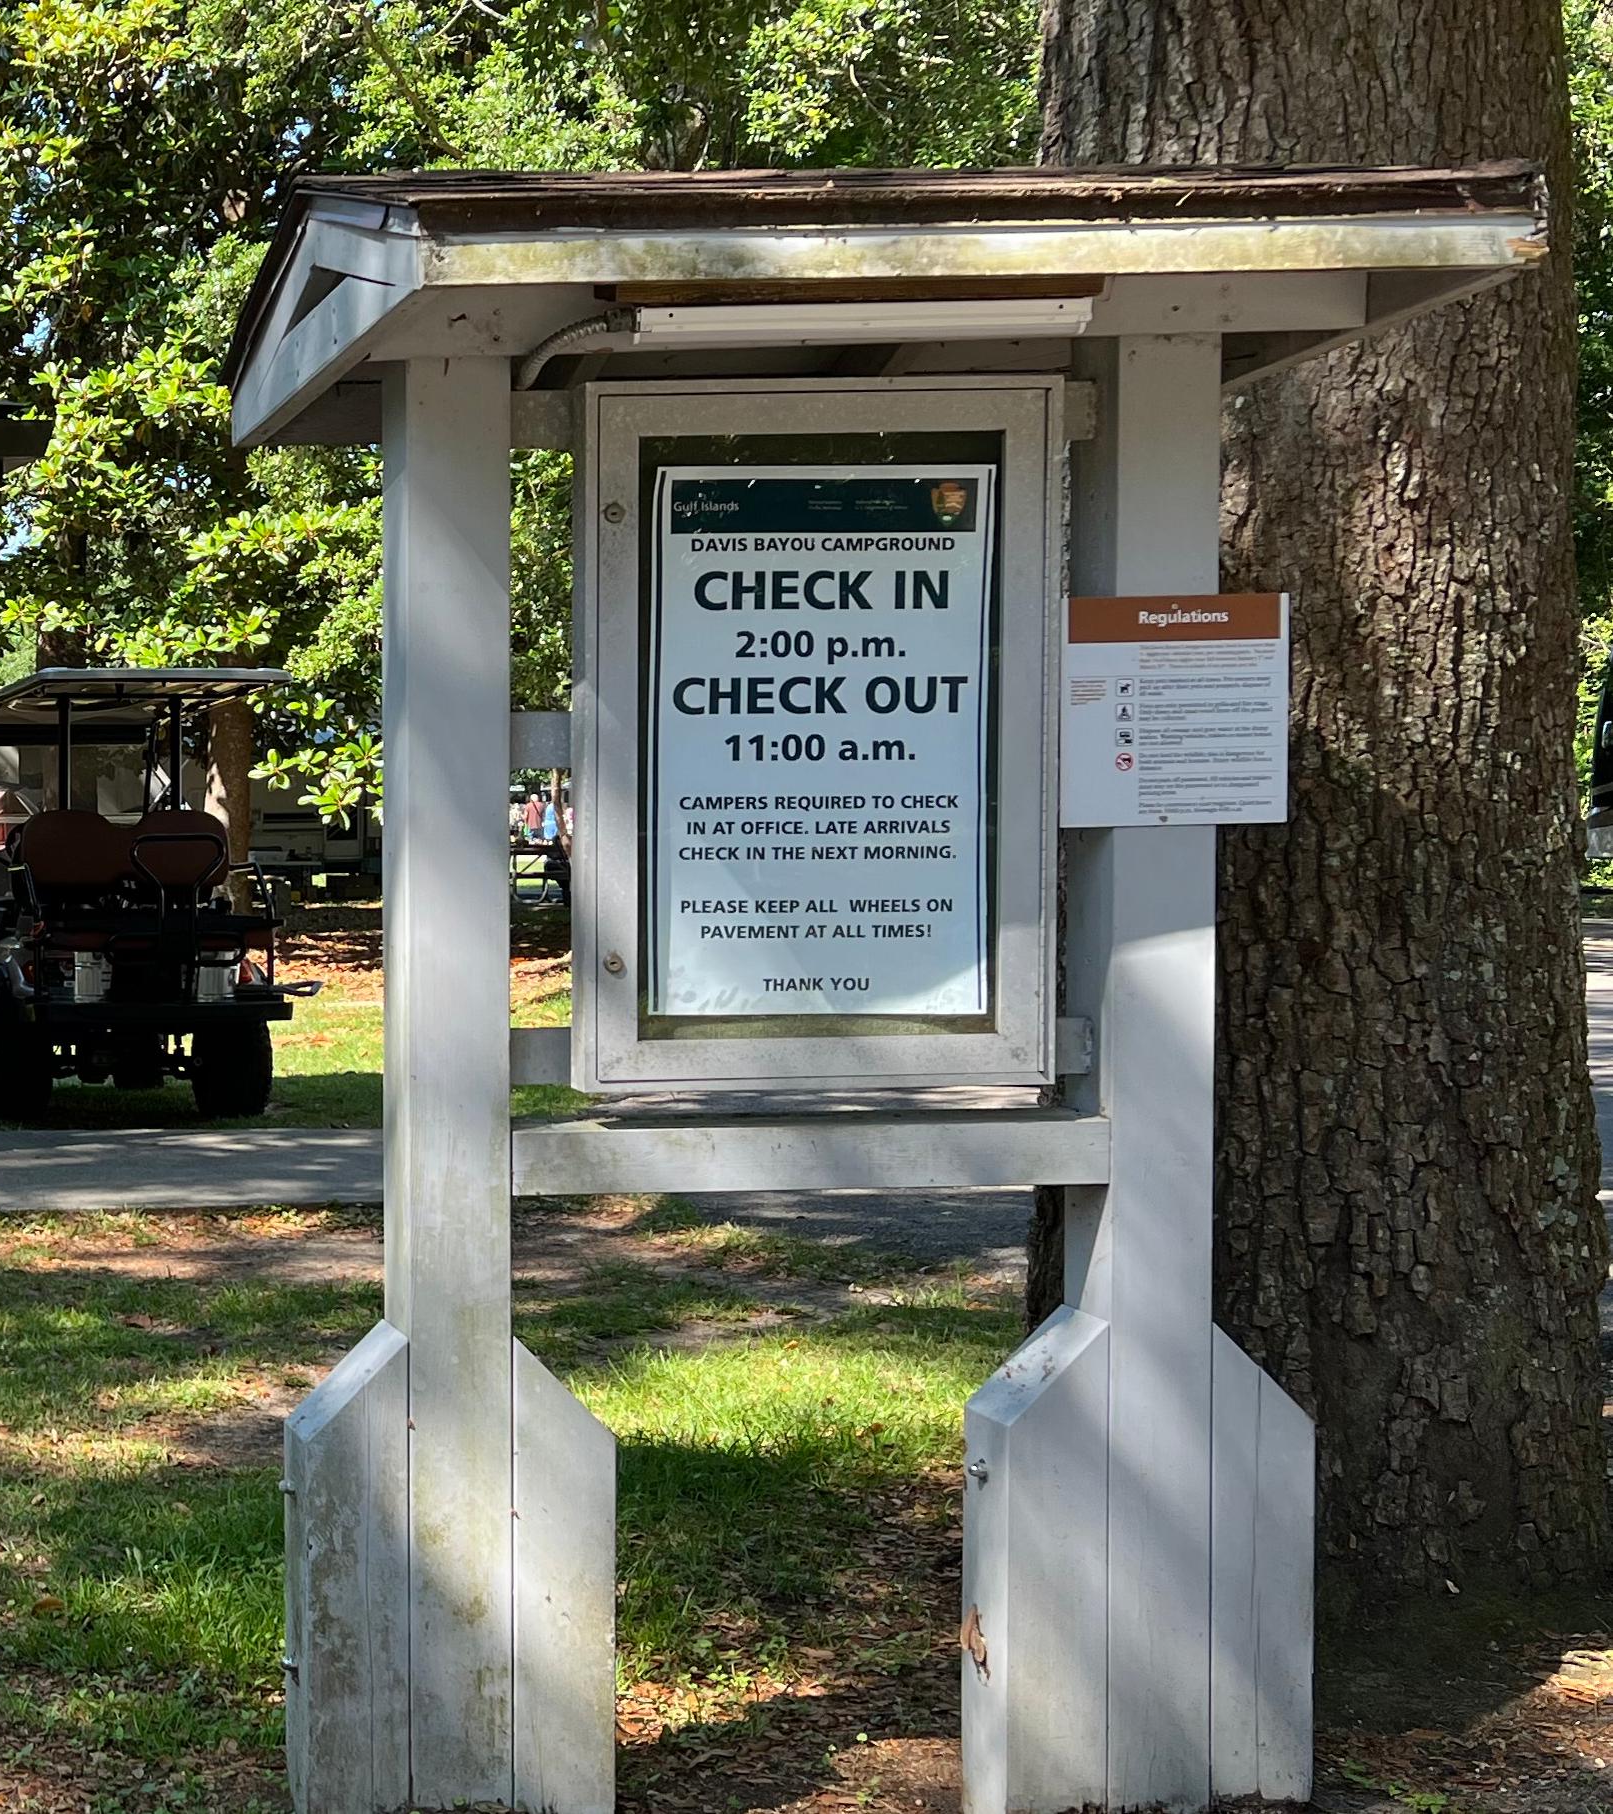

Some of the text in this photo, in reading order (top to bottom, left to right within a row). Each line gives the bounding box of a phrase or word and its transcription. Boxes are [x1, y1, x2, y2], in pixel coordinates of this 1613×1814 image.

[673, 500, 739, 513] Gulf Islands
[691, 537, 955, 553] DAVIS BAYOU CAMPGROUND
[693, 571, 949, 610] CHECK IN
[1139, 608, 1228, 627] Regulations
[734, 631, 906, 664] 2:00 p.m.
[672, 676, 968, 714] CHECK OUT
[724, 734, 916, 761] 11:00 a.m.
[679, 795, 959, 811] CAMPERS REQUIRED TO CHECK
[687, 820, 951, 835] IN AT OFFICE. LATE ARRIVALS
[679, 845, 957, 861] CHECK IN THE NEXT MORNING.
[680, 898, 954, 914] PLEASE KEEP ALL WHEELS ON
[701, 924, 932, 939] PAVEMENT AT ALL TIMES!
[764, 976, 870, 992] THANK YOU
